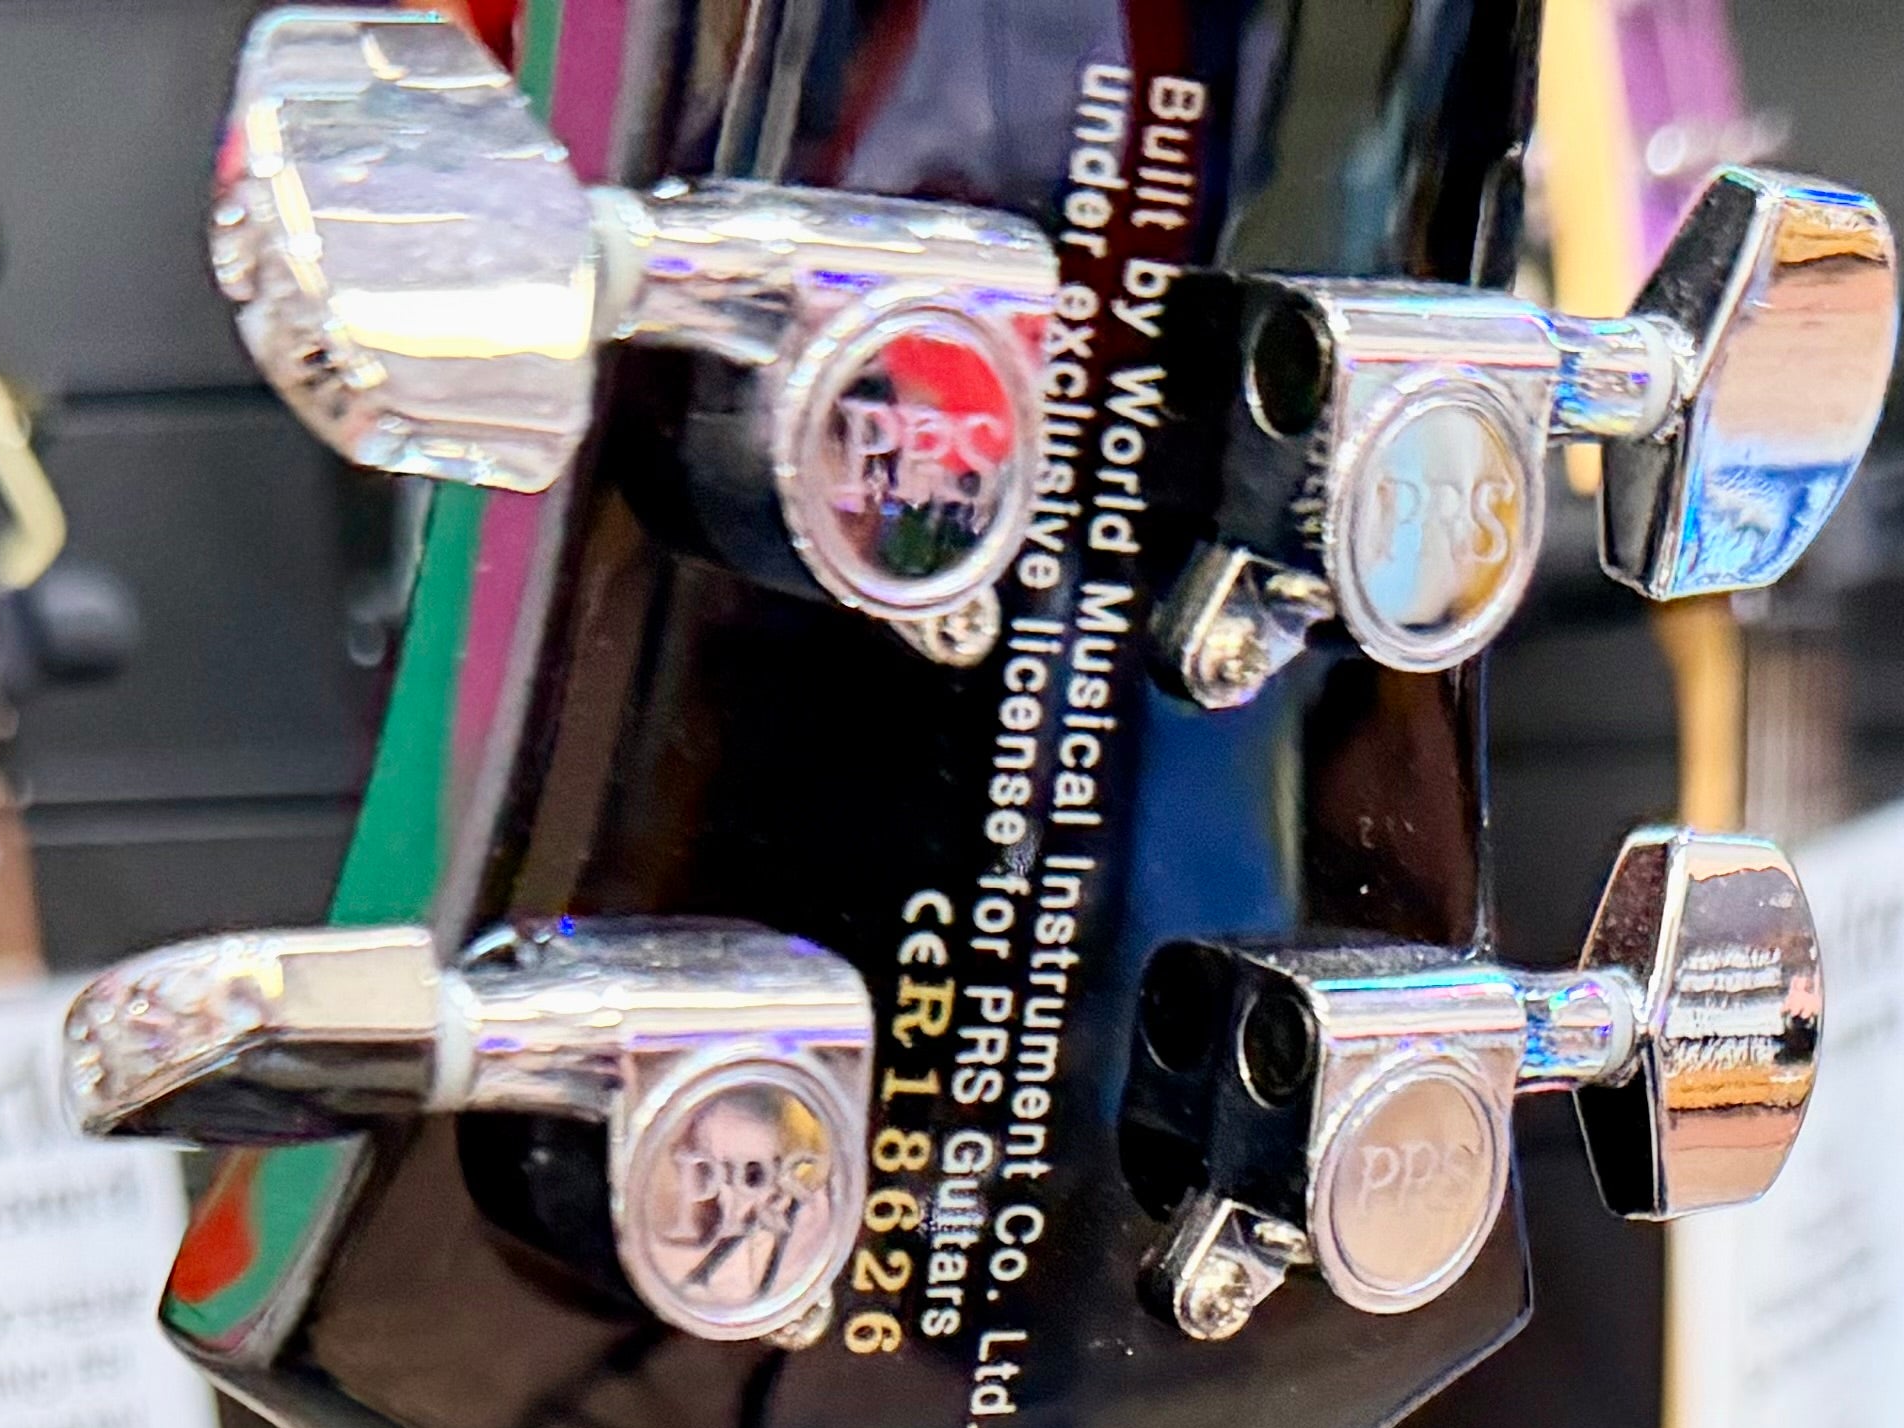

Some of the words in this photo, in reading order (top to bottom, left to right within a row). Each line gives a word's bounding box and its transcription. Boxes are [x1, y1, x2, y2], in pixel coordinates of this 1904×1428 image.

[1060, 63, 1133, 259] under
[1130, 75, 1208, 231] Built
[1109, 257, 1184, 338] by
[1017, 282, 1100, 590] exclusive
[1088, 364, 1168, 555] World
[1366, 478, 1516, 566] PRS
[983, 616, 1067, 845] license
[1050, 581, 1135, 826] Musical
[968, 875, 1031, 960] for
[950, 985, 1015, 1104] PRS
[1001, 855, 1096, 1180] Instrument
[920, 1129, 994, 1338] Guitars
[985, 1203, 1045, 1301] Co.
